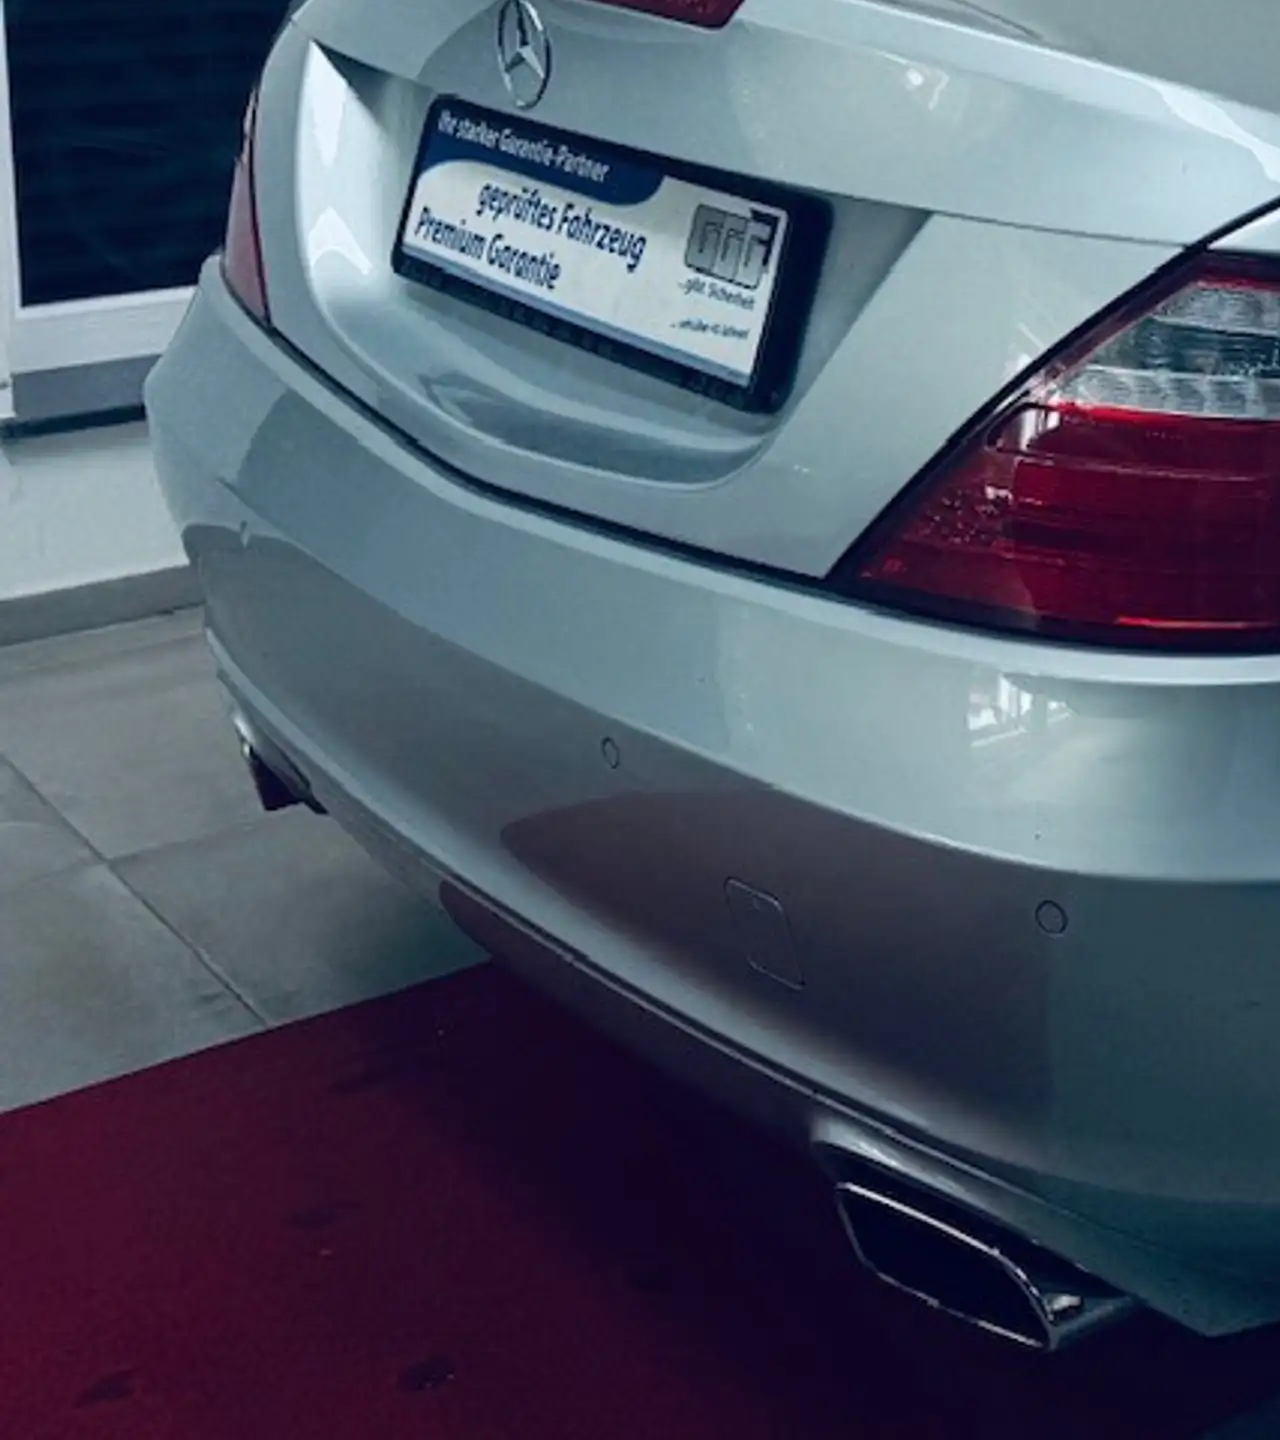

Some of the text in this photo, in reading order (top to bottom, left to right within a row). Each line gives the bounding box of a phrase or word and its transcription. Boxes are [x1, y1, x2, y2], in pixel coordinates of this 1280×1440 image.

[437, 109, 611, 183] Ihr starker Garantie-Partner
[414, 206, 562, 290] Premium Garantie
[476, 183, 557, 232] geprüftes
[557, 201, 648, 273] Fahrzeug
